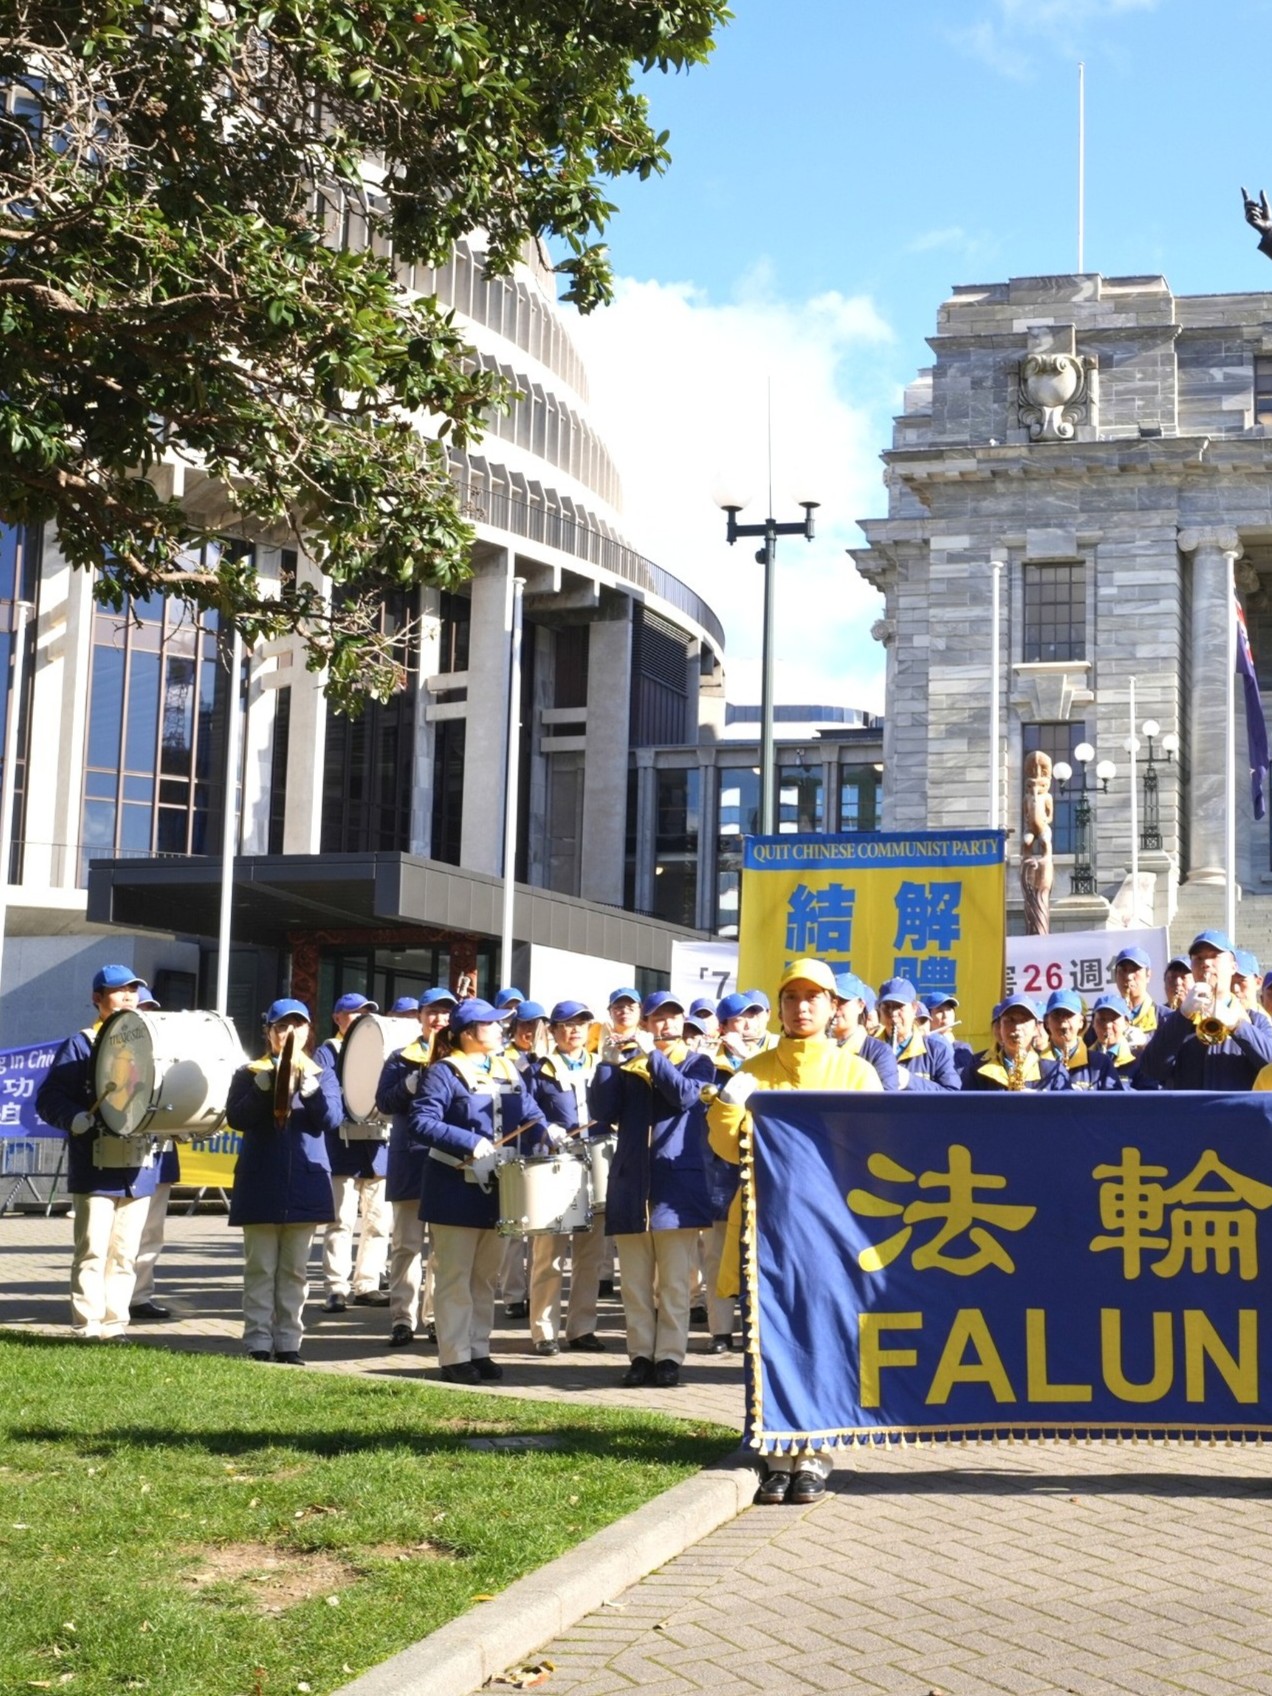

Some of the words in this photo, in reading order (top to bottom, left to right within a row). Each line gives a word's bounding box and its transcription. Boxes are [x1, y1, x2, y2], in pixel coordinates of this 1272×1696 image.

[753, 844, 791, 863] QUIT
[793, 842, 856, 860] CHINESE
[857, 841, 950, 859] COMMUNIST
[951, 838, 999, 856] PARTY
[10, 1054, 24, 1069] in
[3, 1077, 35, 1098] 功
[858, 1307, 1259, 1408] FALUN
